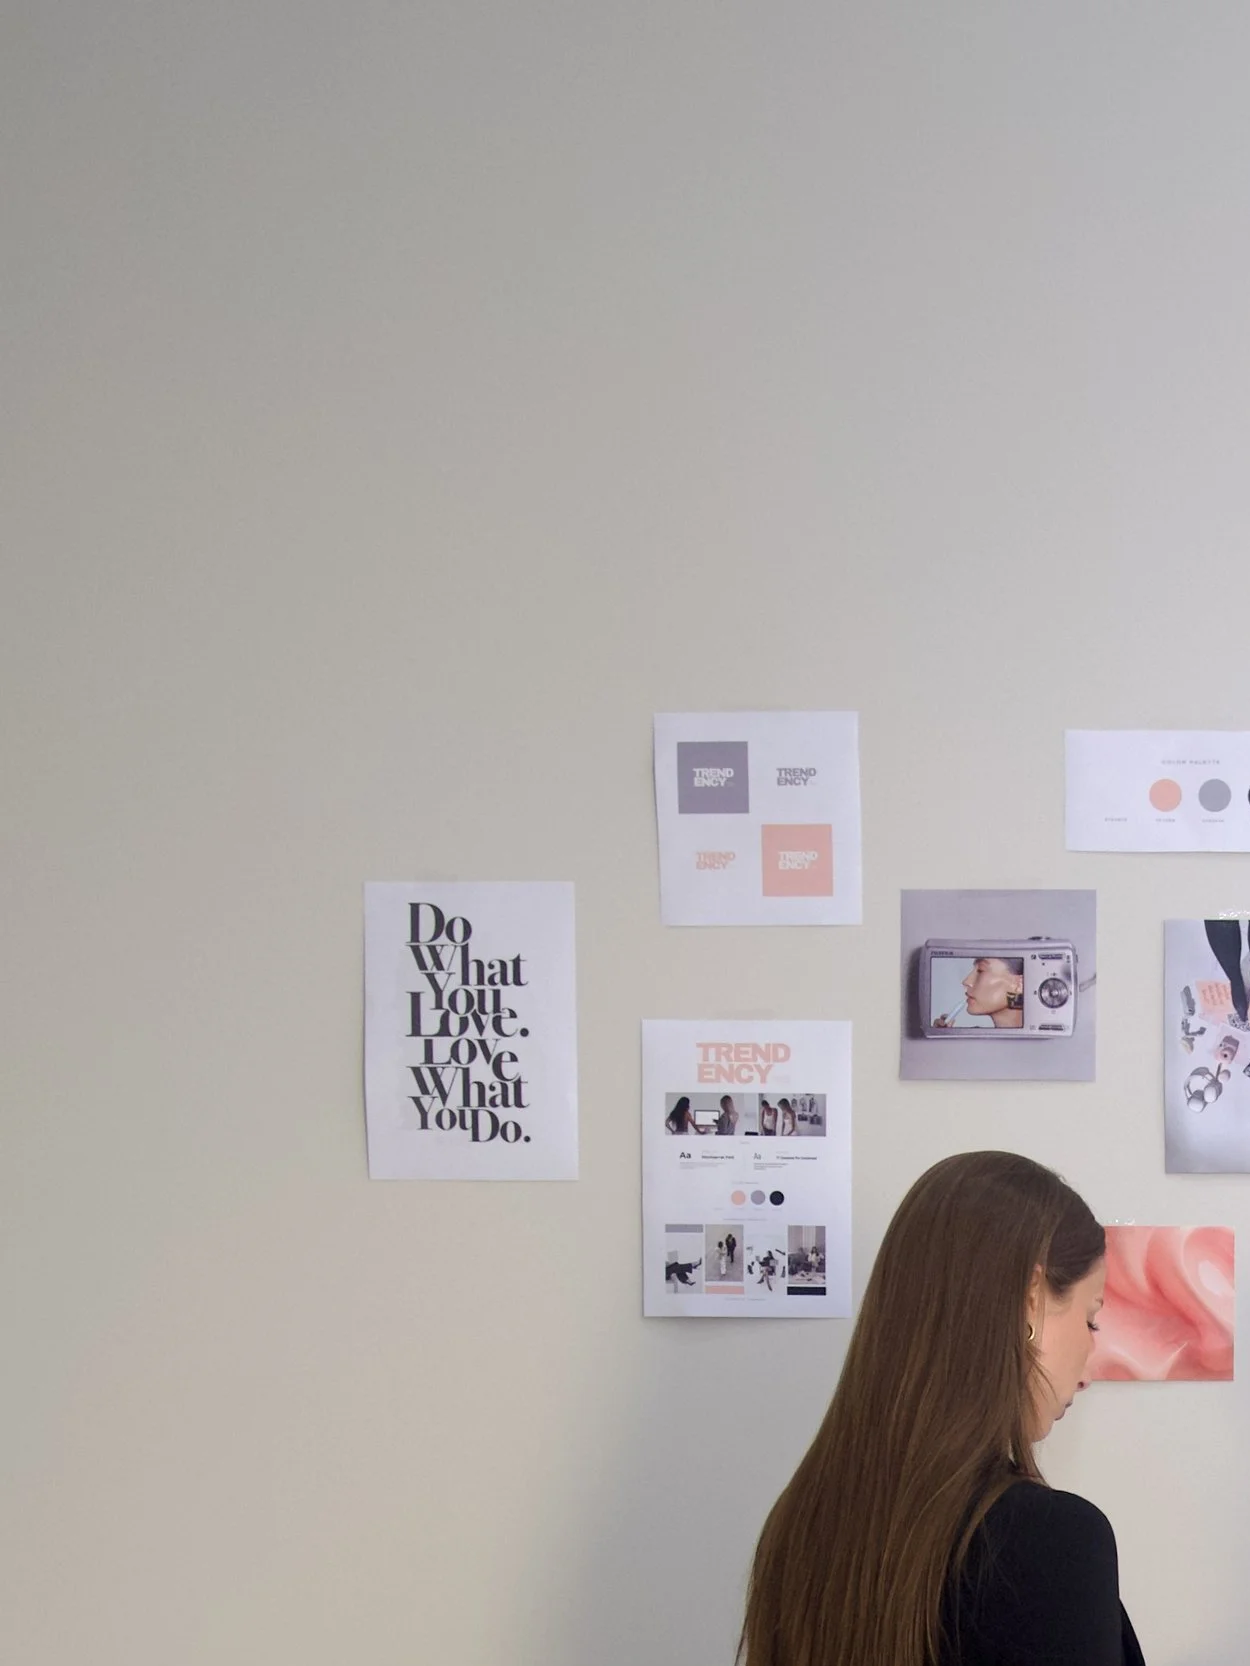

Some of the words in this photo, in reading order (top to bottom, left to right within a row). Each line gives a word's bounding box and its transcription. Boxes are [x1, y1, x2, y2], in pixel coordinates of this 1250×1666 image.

[692, 768, 734, 778] TREND
[777, 767, 817, 777] TREND
[693, 777, 727, 787] ENCY
[777, 777, 809, 786] ENCY
[696, 851, 735, 861] TREND
[778, 851, 818, 861] TREND
[696, 861, 728, 870] ENCY
[778, 860, 811, 870] ENCY
[408, 902, 472, 944] Do
[405, 943, 529, 986] What
[421, 972, 503, 1015] You
[696, 1042, 791, 1063] TREND
[420, 1037, 520, 1082] Love
[697, 1063, 773, 1084] ENCY
[406, 1066, 530, 1109] What
[679, 1151, 691, 1160] Aa
